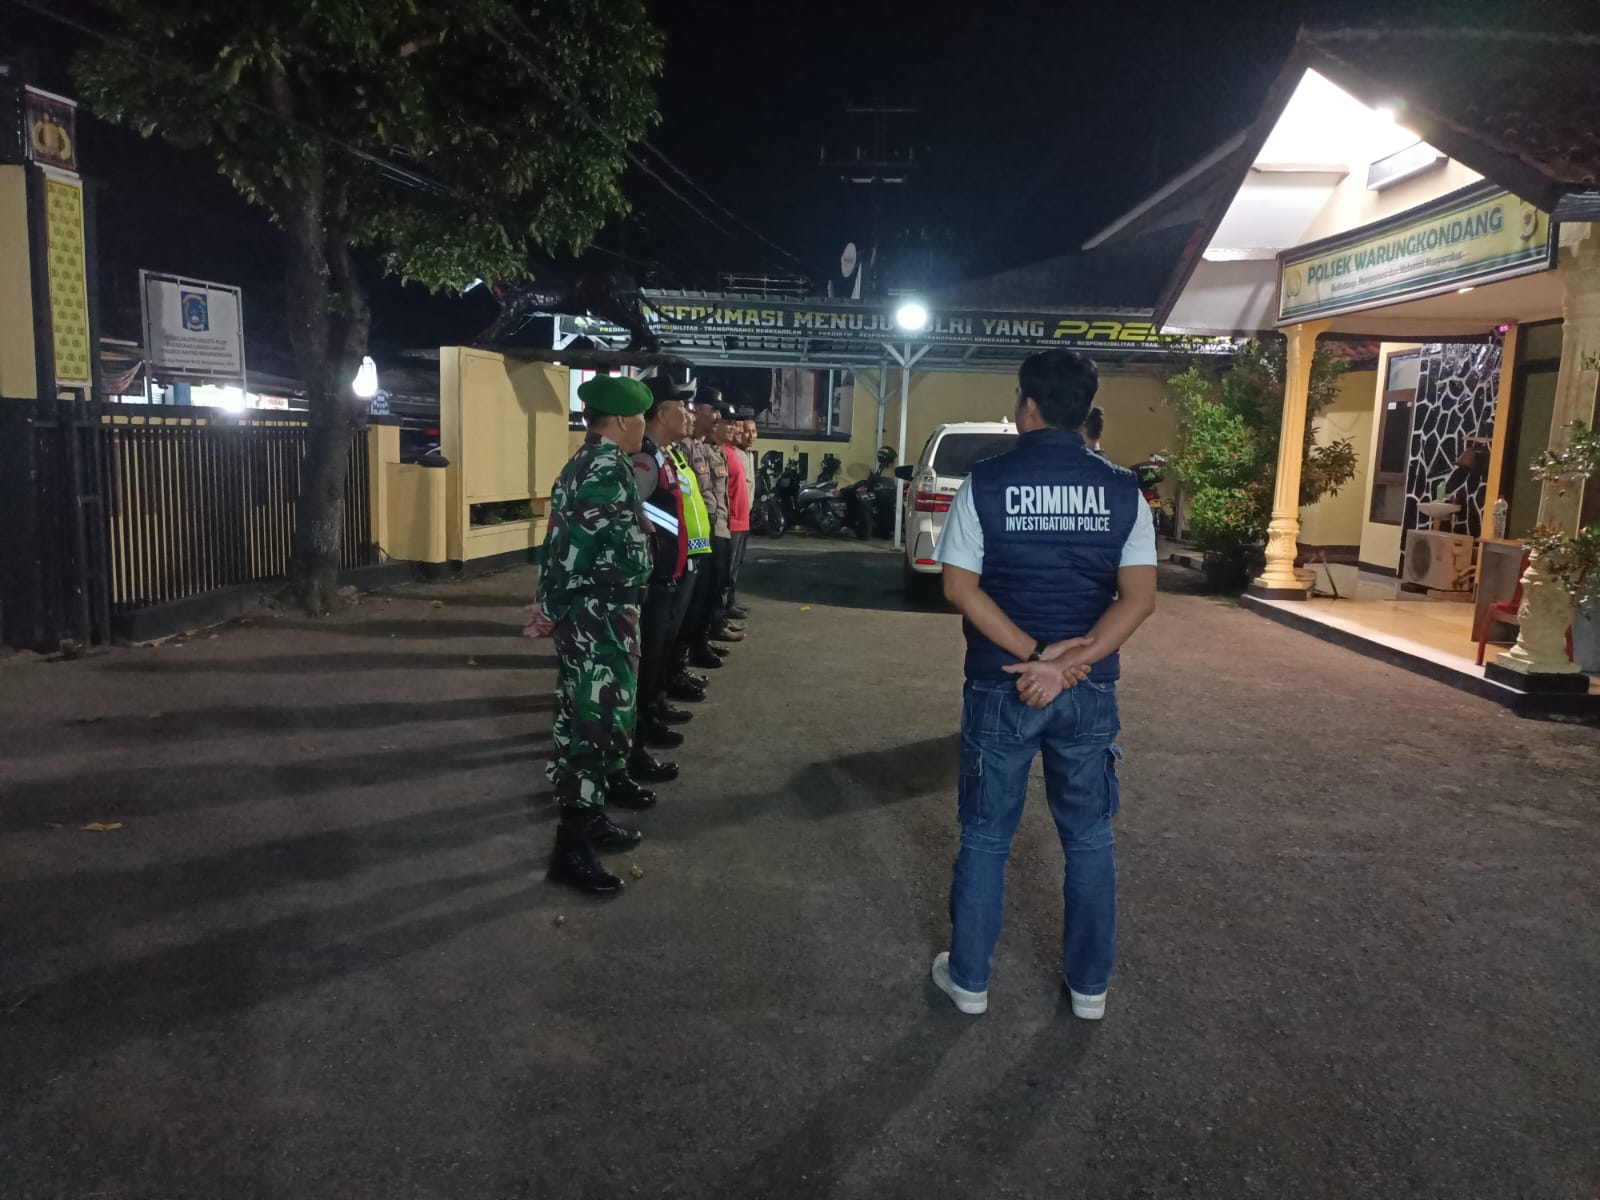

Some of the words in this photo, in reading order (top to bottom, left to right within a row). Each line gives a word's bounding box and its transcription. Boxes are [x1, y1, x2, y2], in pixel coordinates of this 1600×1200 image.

[1308, 255, 1352, 285] POLSEK
[1355, 206, 1503, 270] WARUNGKONDANG
[642, 305, 784, 327] NSFORMASI
[793, 312, 894, 331] MENUJU
[982, 319, 1045, 337] YANG
[1005, 485, 1111, 515] CRIMINAL
[1005, 516, 1076, 532] INVESTIGATION
[1078, 516, 1110, 532] POLICE
